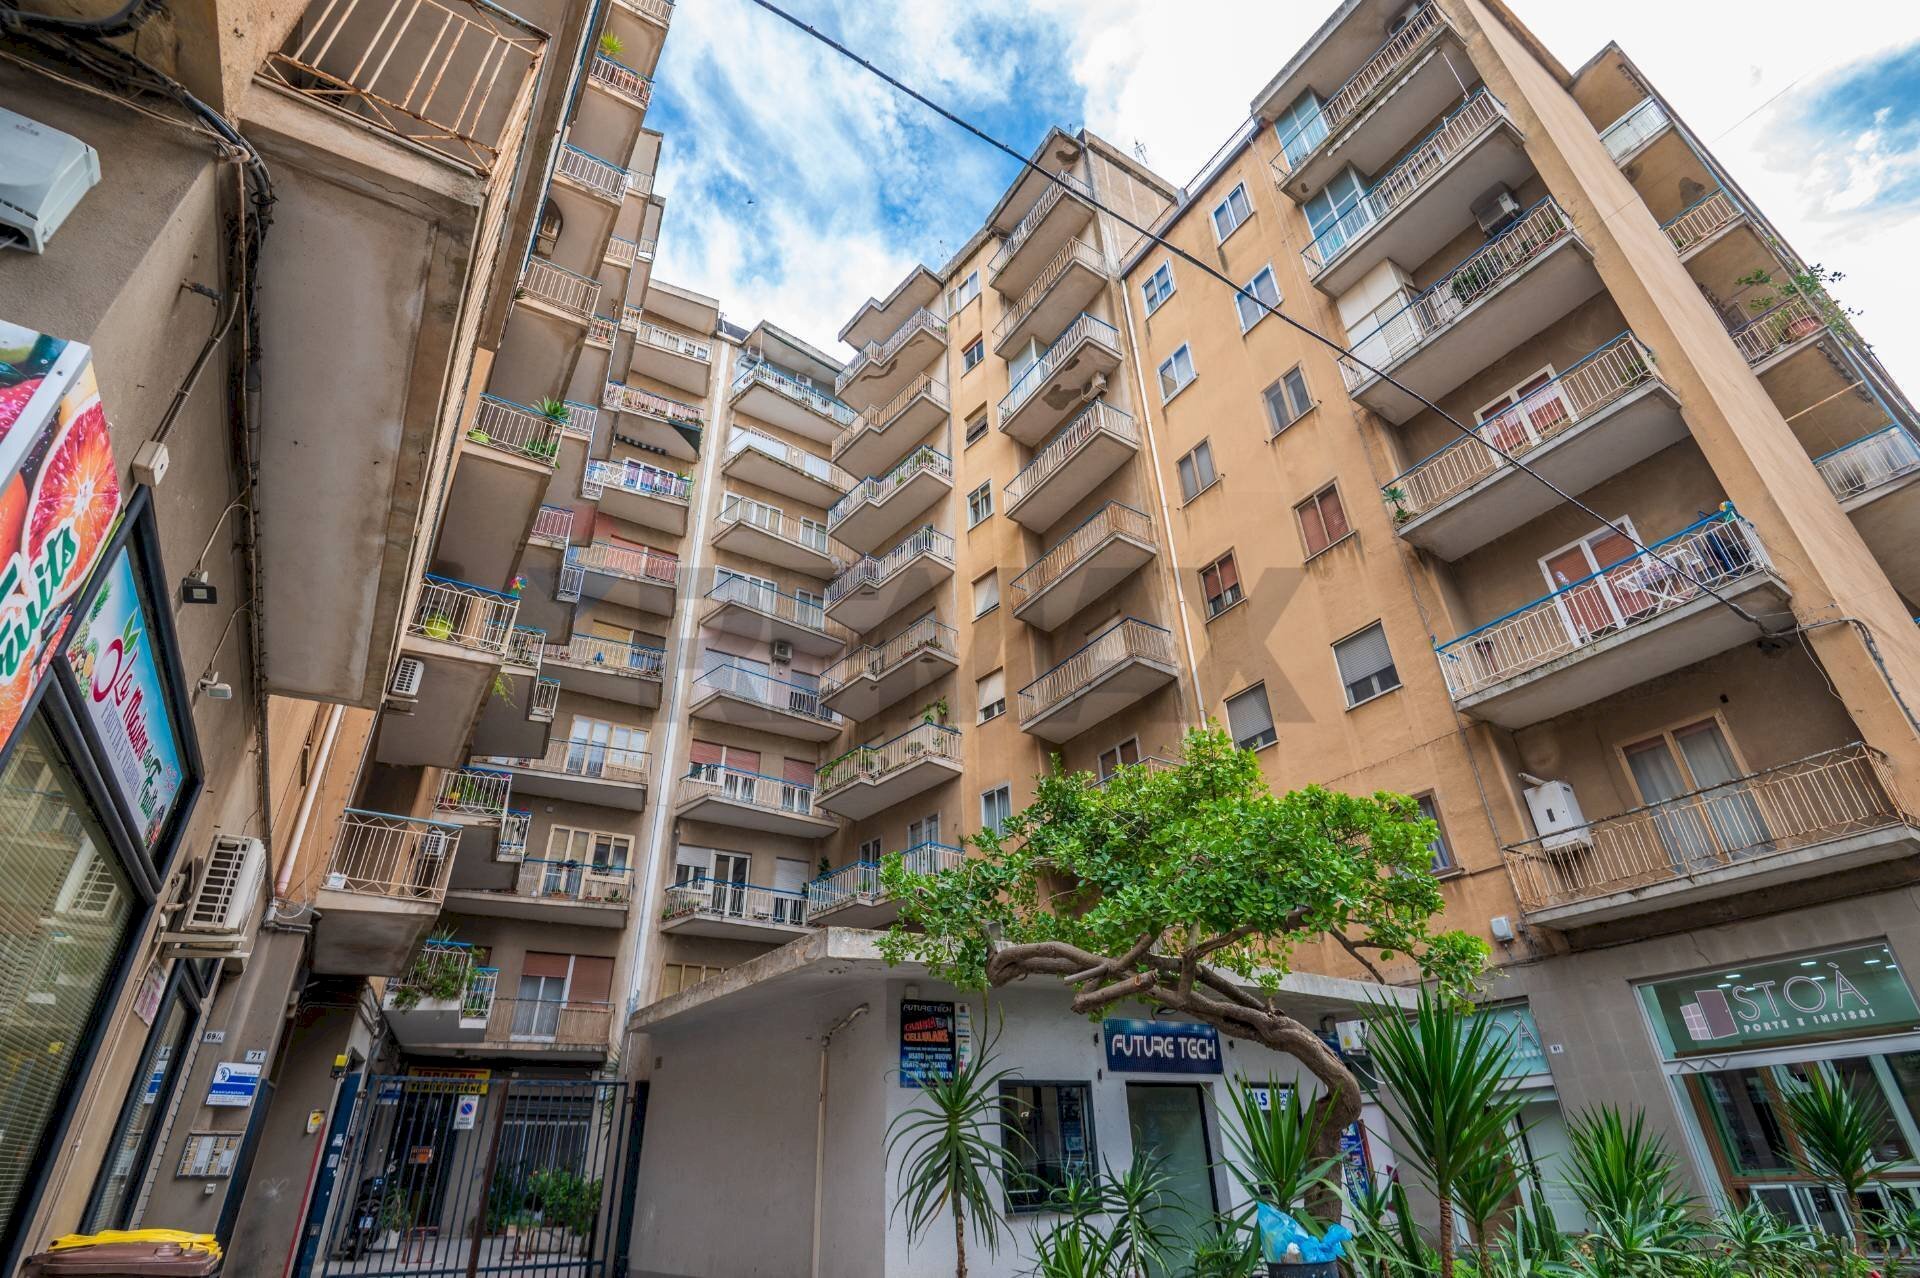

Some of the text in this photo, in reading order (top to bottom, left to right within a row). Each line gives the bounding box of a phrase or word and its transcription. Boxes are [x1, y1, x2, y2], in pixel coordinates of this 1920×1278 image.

[114, 650, 137, 706] La
[100, 696, 124, 752] FRUTTA
[122, 684, 148, 761] Maison
[138, 757, 163, 820] Fruits
[1732, 962, 1869, 1021] STOÀ
[1112, 1034, 1216, 1060] FUTURE TECH
[1744, 1017, 1789, 1033] PORTE
[1813, 1008, 1876, 1024] INFISSI
